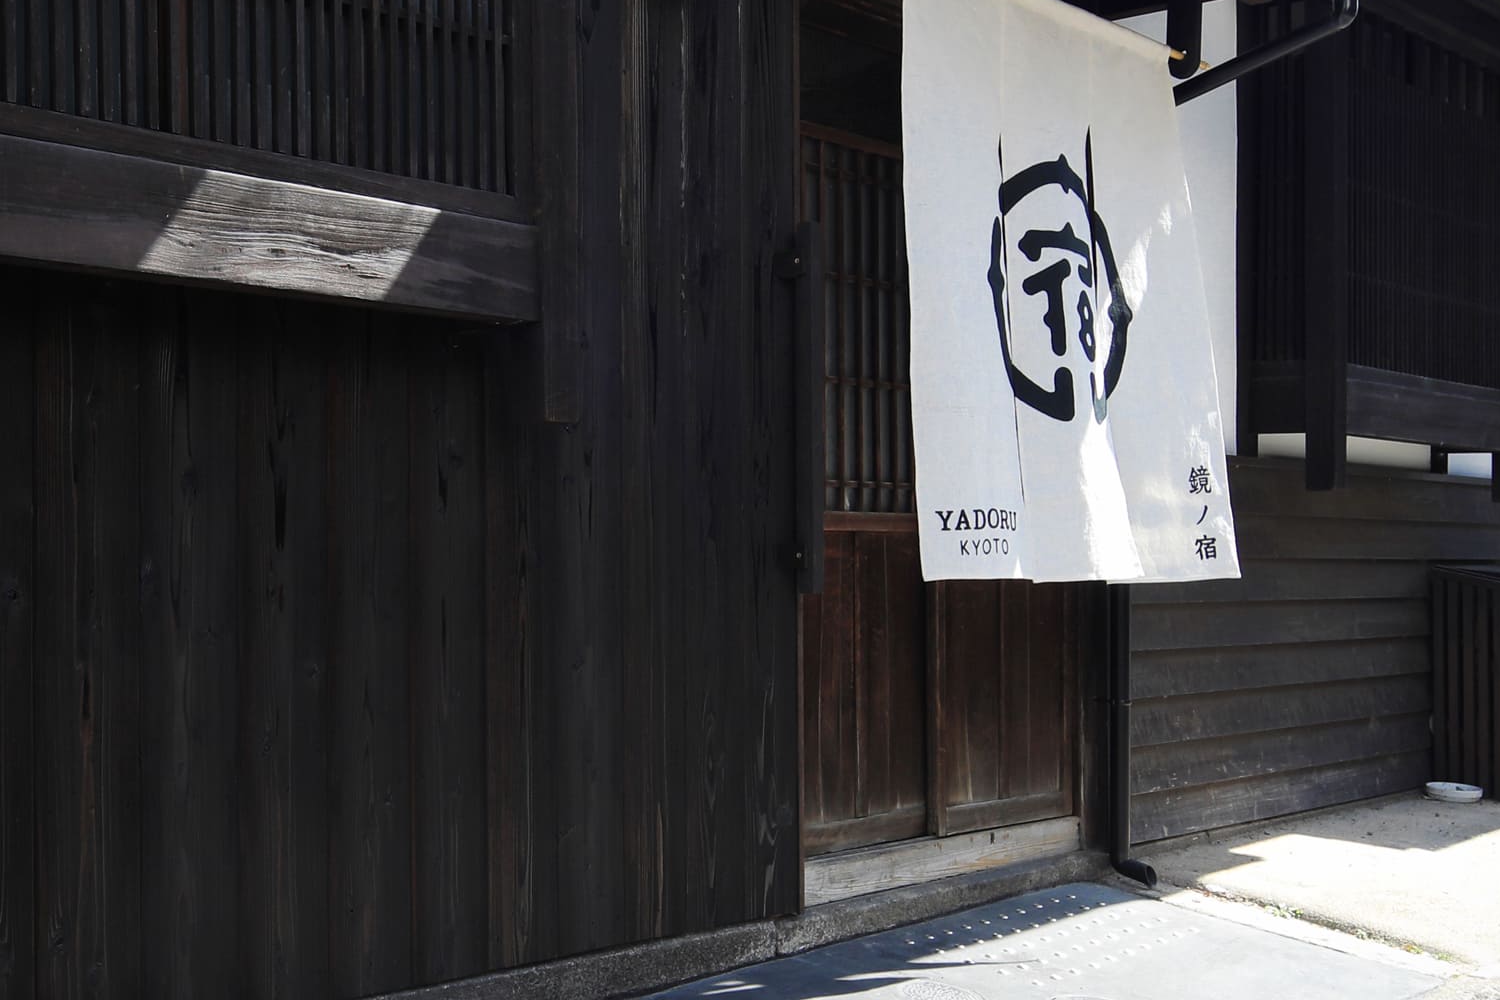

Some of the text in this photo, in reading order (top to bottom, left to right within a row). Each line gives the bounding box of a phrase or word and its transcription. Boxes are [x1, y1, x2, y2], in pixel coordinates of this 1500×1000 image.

[935, 508, 1017, 531] YADORU
[1188, 465, 1217, 561] 鏡ノ宿
[960, 538, 1009, 556] KYOTO
